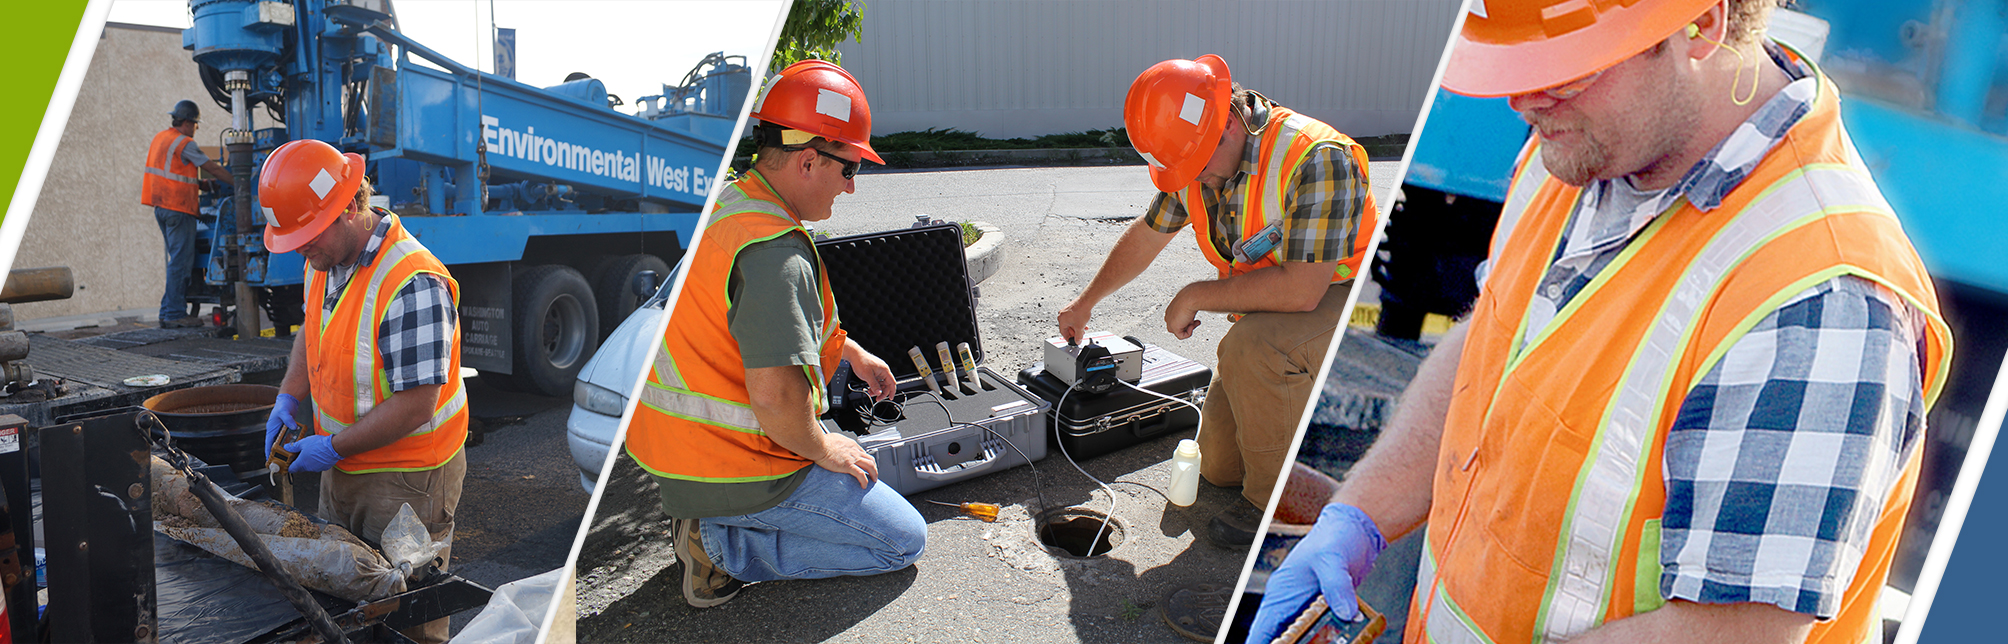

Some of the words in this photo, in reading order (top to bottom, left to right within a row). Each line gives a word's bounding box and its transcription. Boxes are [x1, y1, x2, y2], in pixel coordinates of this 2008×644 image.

[482, 114, 640, 183] Environmental
[647, 155, 690, 193] West
[693, 167, 715, 197] Ex
[462, 306, 505, 318] WASHINGTON
[472, 320, 490, 331] AUTO
[465, 332, 498, 345] CARRIAGE
